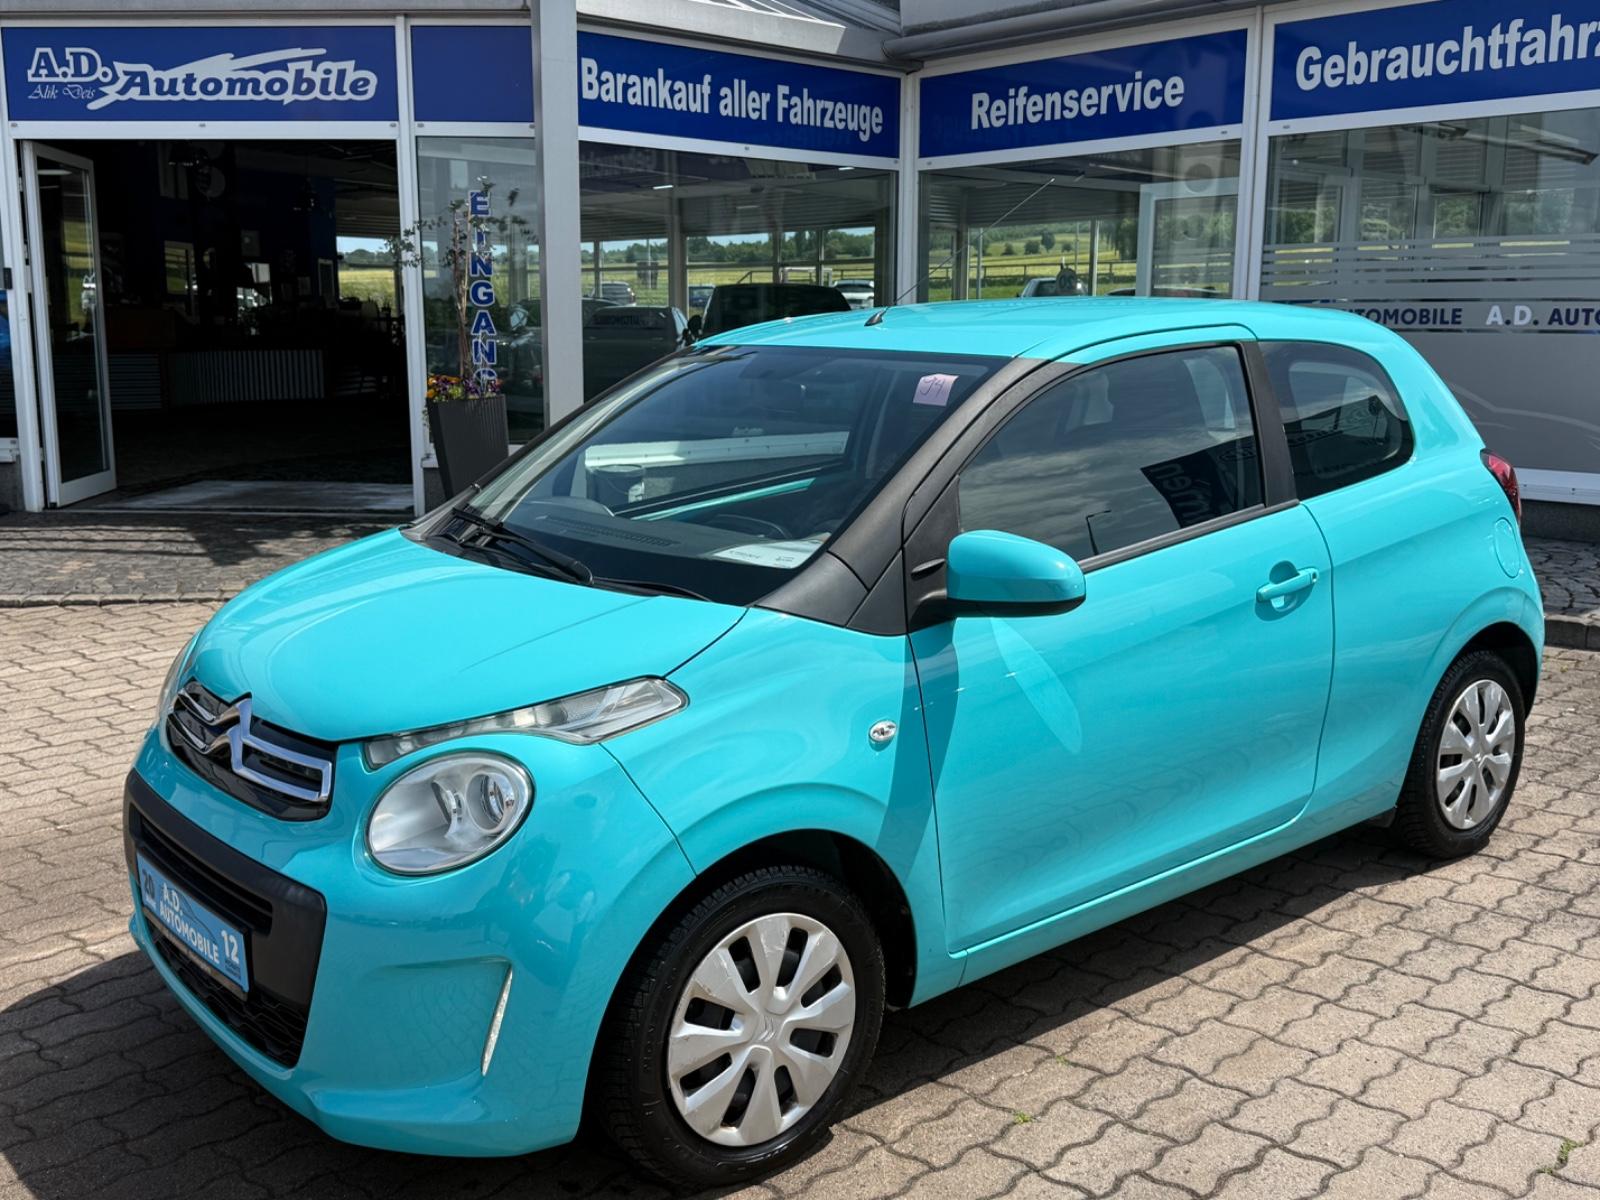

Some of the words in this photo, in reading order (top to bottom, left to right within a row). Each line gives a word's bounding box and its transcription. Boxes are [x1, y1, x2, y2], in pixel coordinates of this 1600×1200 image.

[28, 48, 112, 82] A.D.
[114, 61, 377, 101] Automobile
[581, 57, 711, 113] Barankauf
[719, 79, 770, 121] aller
[777, 85, 883, 142] Fahrzeuge
[971, 71, 1184, 129] Reifenservice
[1486, 305, 1539, 326] A.D.
[160, 899, 220, 964] AUTOMOBILE
[221, 930, 239, 964] 12
